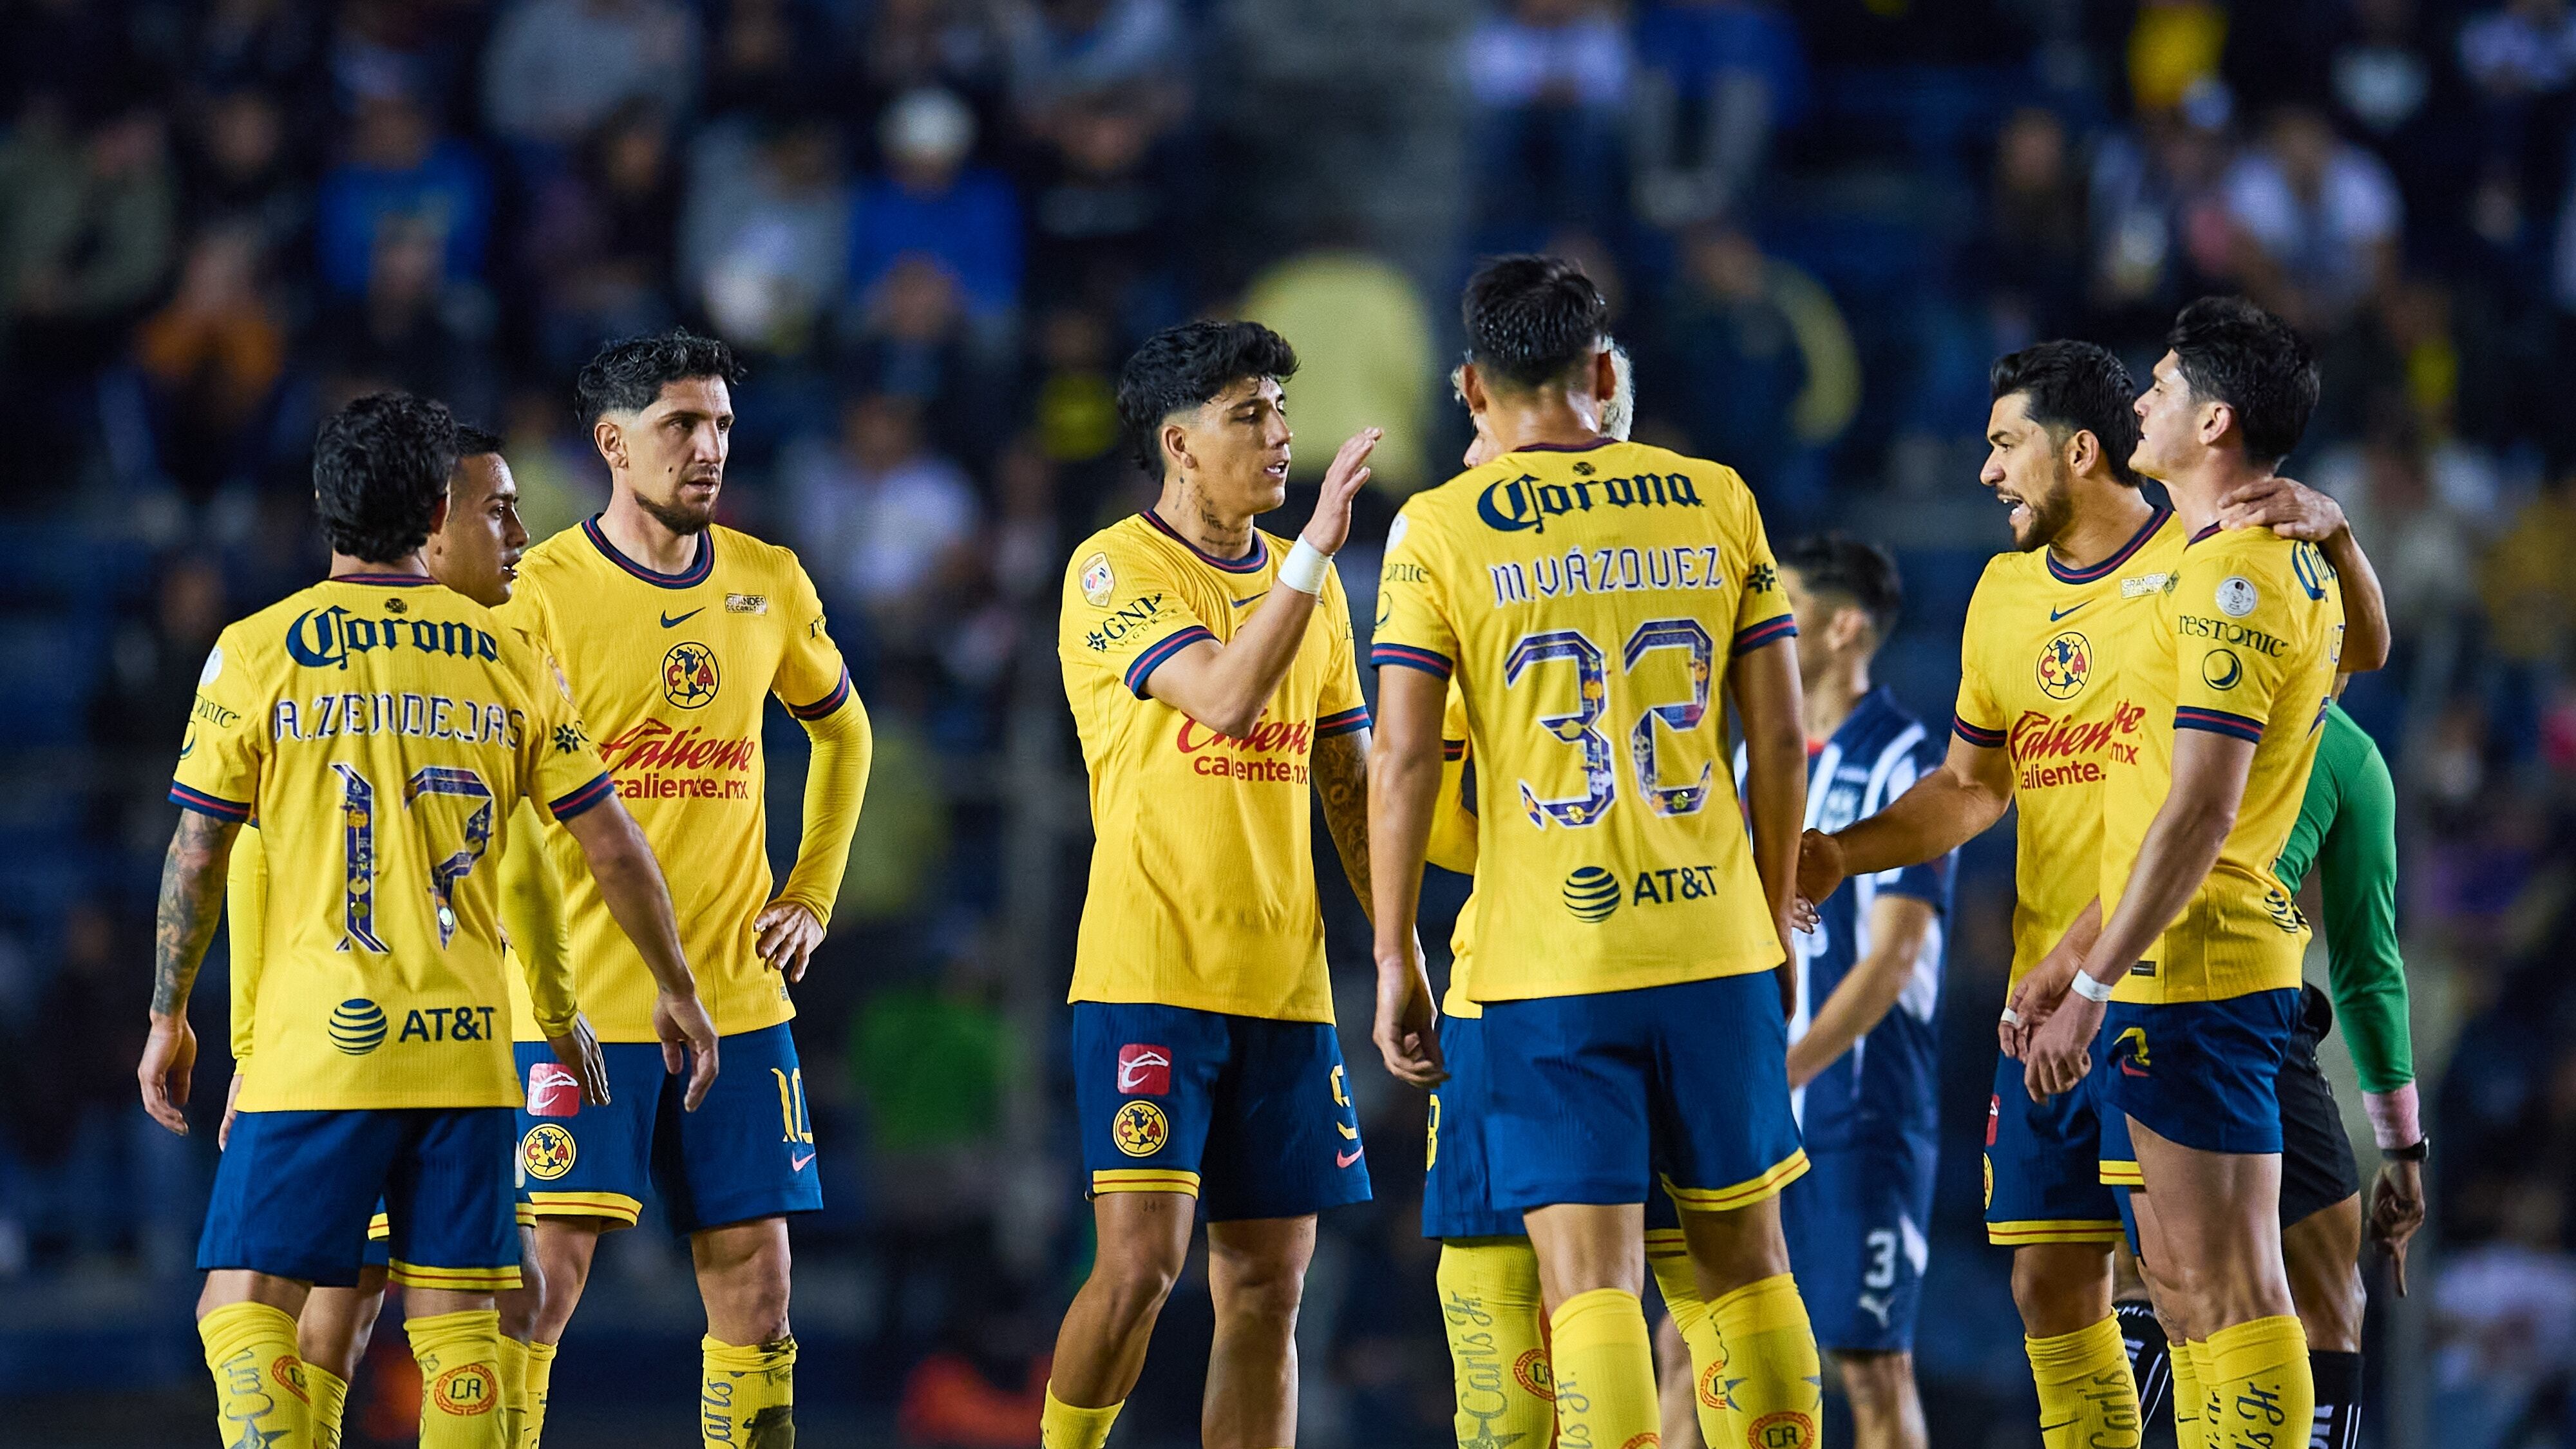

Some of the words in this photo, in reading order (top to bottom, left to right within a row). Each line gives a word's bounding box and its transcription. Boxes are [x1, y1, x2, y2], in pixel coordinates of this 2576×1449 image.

[1477, 473, 1704, 534] Corona
[727, 596, 765, 606] GRANDES
[1490, 545, 1723, 608] M.VÁZQUEZ
[286, 605, 504, 670] Corona
[274, 694, 526, 748] A.ZENDEJAS
[1504, 618, 1713, 831] 32
[328, 762, 494, 954] 17
[1633, 866, 1717, 906] AT&T
[399, 1007, 496, 1043] AT&T
[771, 1068, 813, 1144] 10
[1426, 1094, 1441, 1171] 8
[1865, 1229, 1896, 1288] 3
[2237, 1381, 2286, 1426] Jr.
